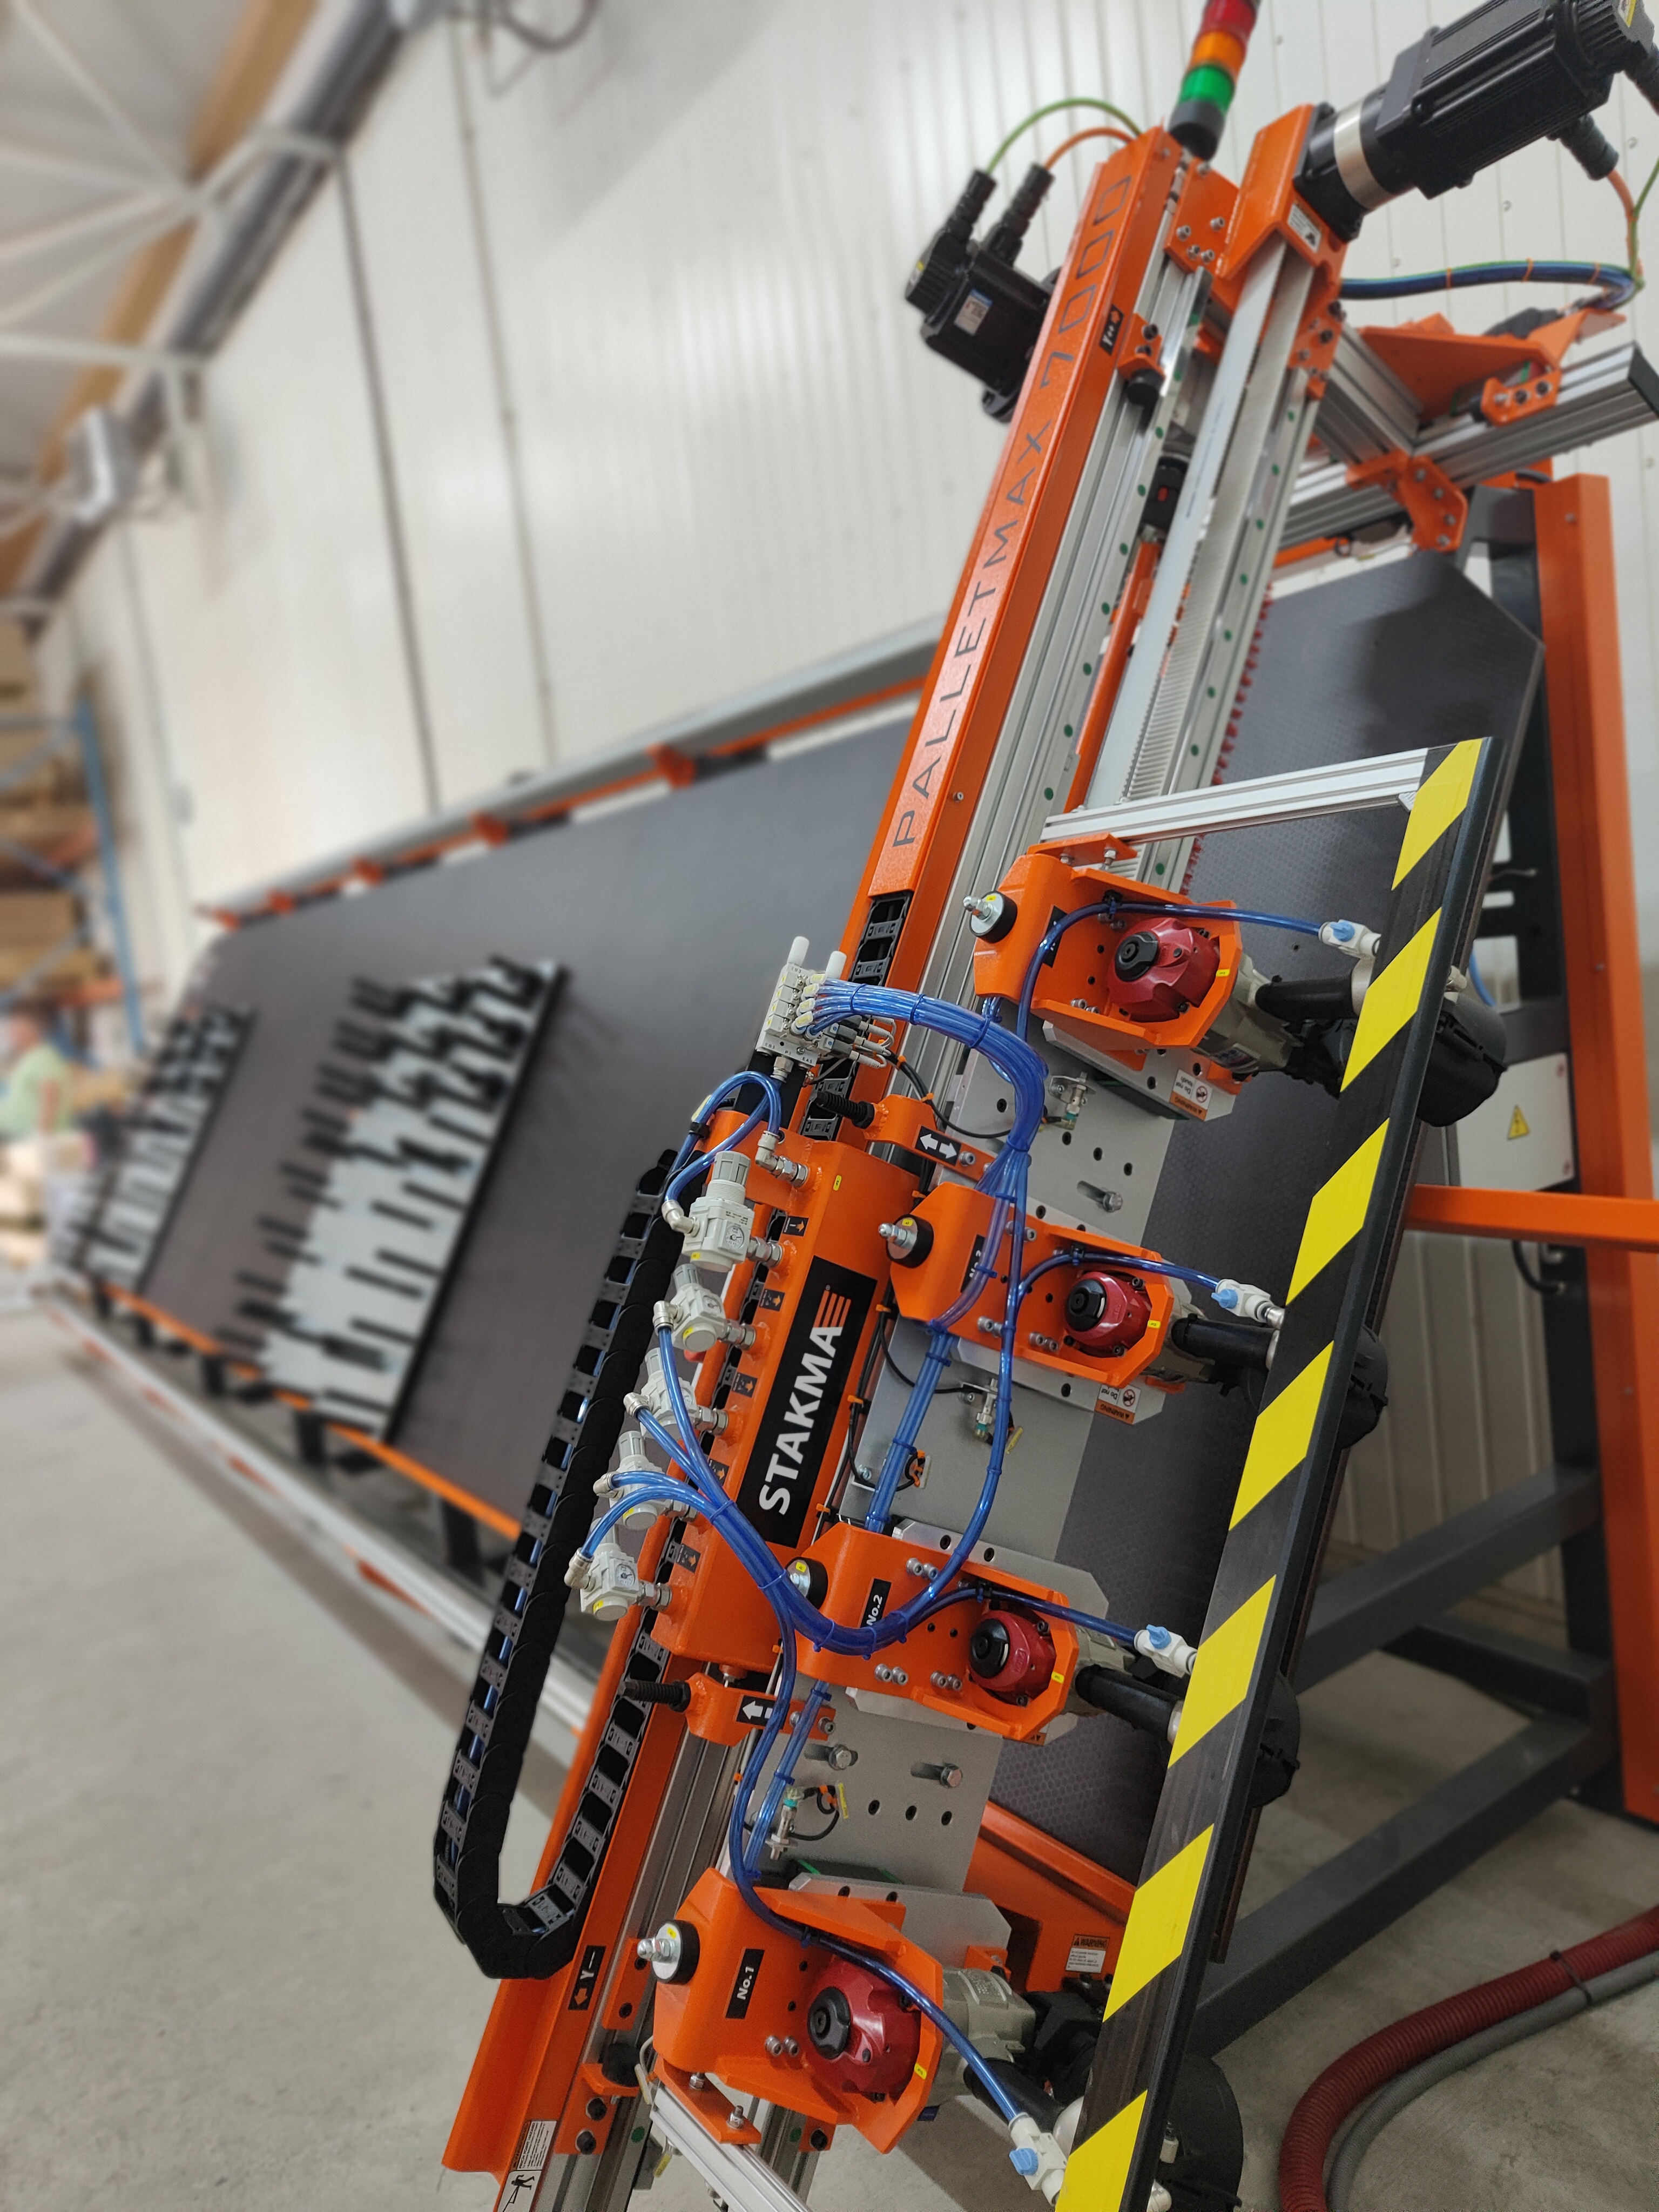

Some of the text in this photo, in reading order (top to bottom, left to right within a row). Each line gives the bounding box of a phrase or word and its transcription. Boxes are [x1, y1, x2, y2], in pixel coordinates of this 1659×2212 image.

[892, 174, 1132, 847] PALLETMAX 7000
[1184, 1086, 1191, 1095] Do
[1174, 1096, 1198, 1113] WARNING
[1110, 1392, 1118, 1400] Do
[759, 1326, 844, 1515] STAKMA
[1100, 1404, 1124, 1419] WARNING
[866, 1594, 883, 1626] No.2
[736, 1966, 754, 2000] No.1
